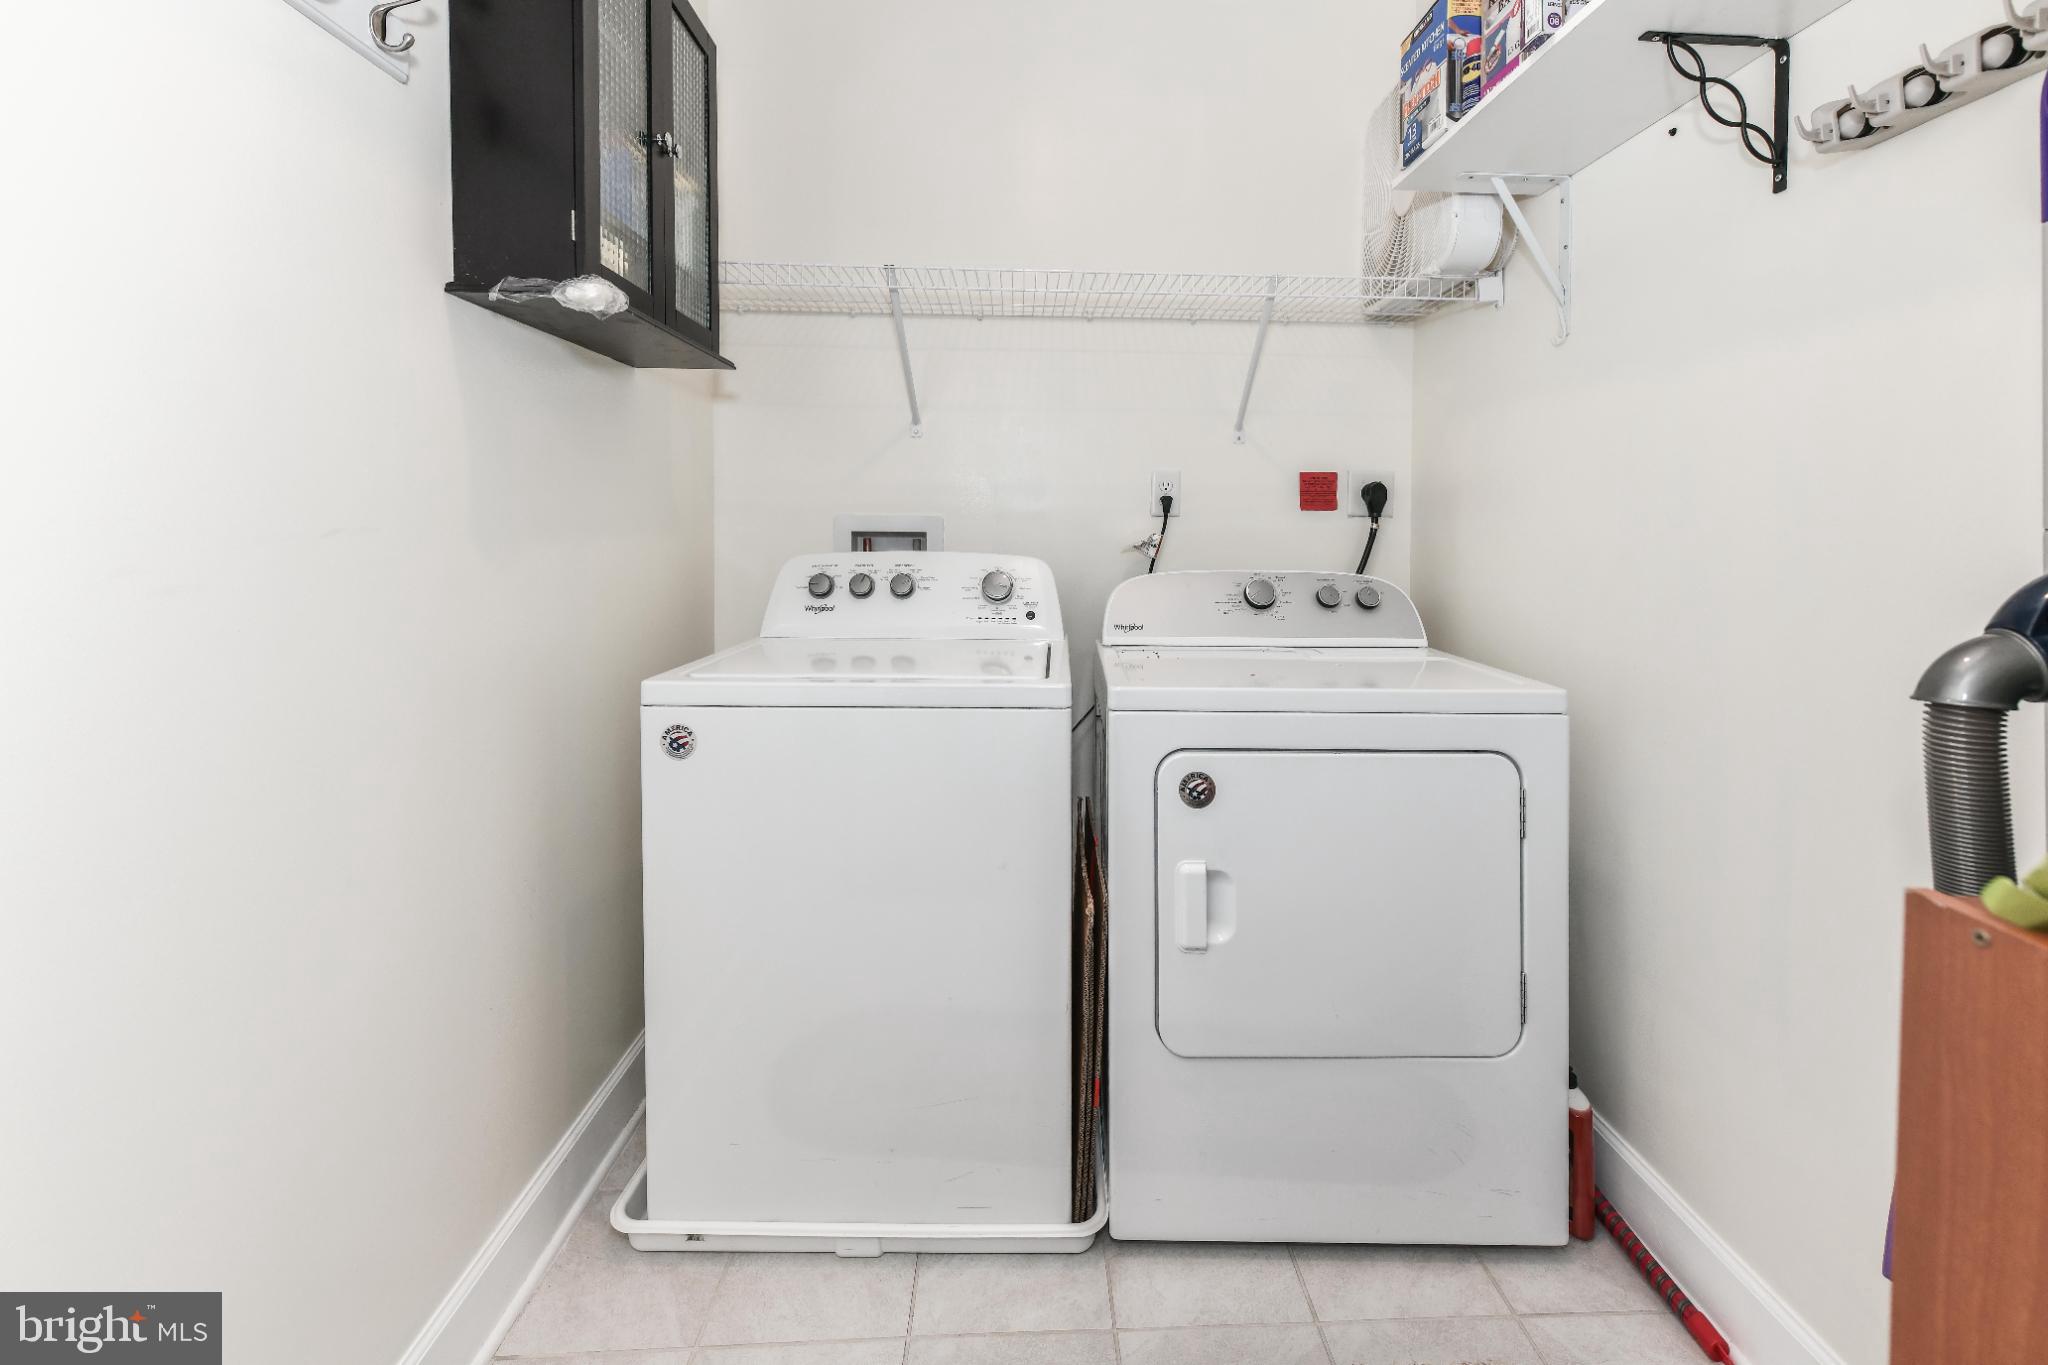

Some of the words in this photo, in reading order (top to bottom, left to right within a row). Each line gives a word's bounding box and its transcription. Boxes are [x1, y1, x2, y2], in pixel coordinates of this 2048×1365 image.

[1421, 21, 1445, 53] KITCHEN
[1407, 122, 1417, 140] 13
[804, 603, 836, 615] Whirlpool
[1113, 622, 1144, 634] Whirlpool
[662, 724, 693, 741] AMERICA
